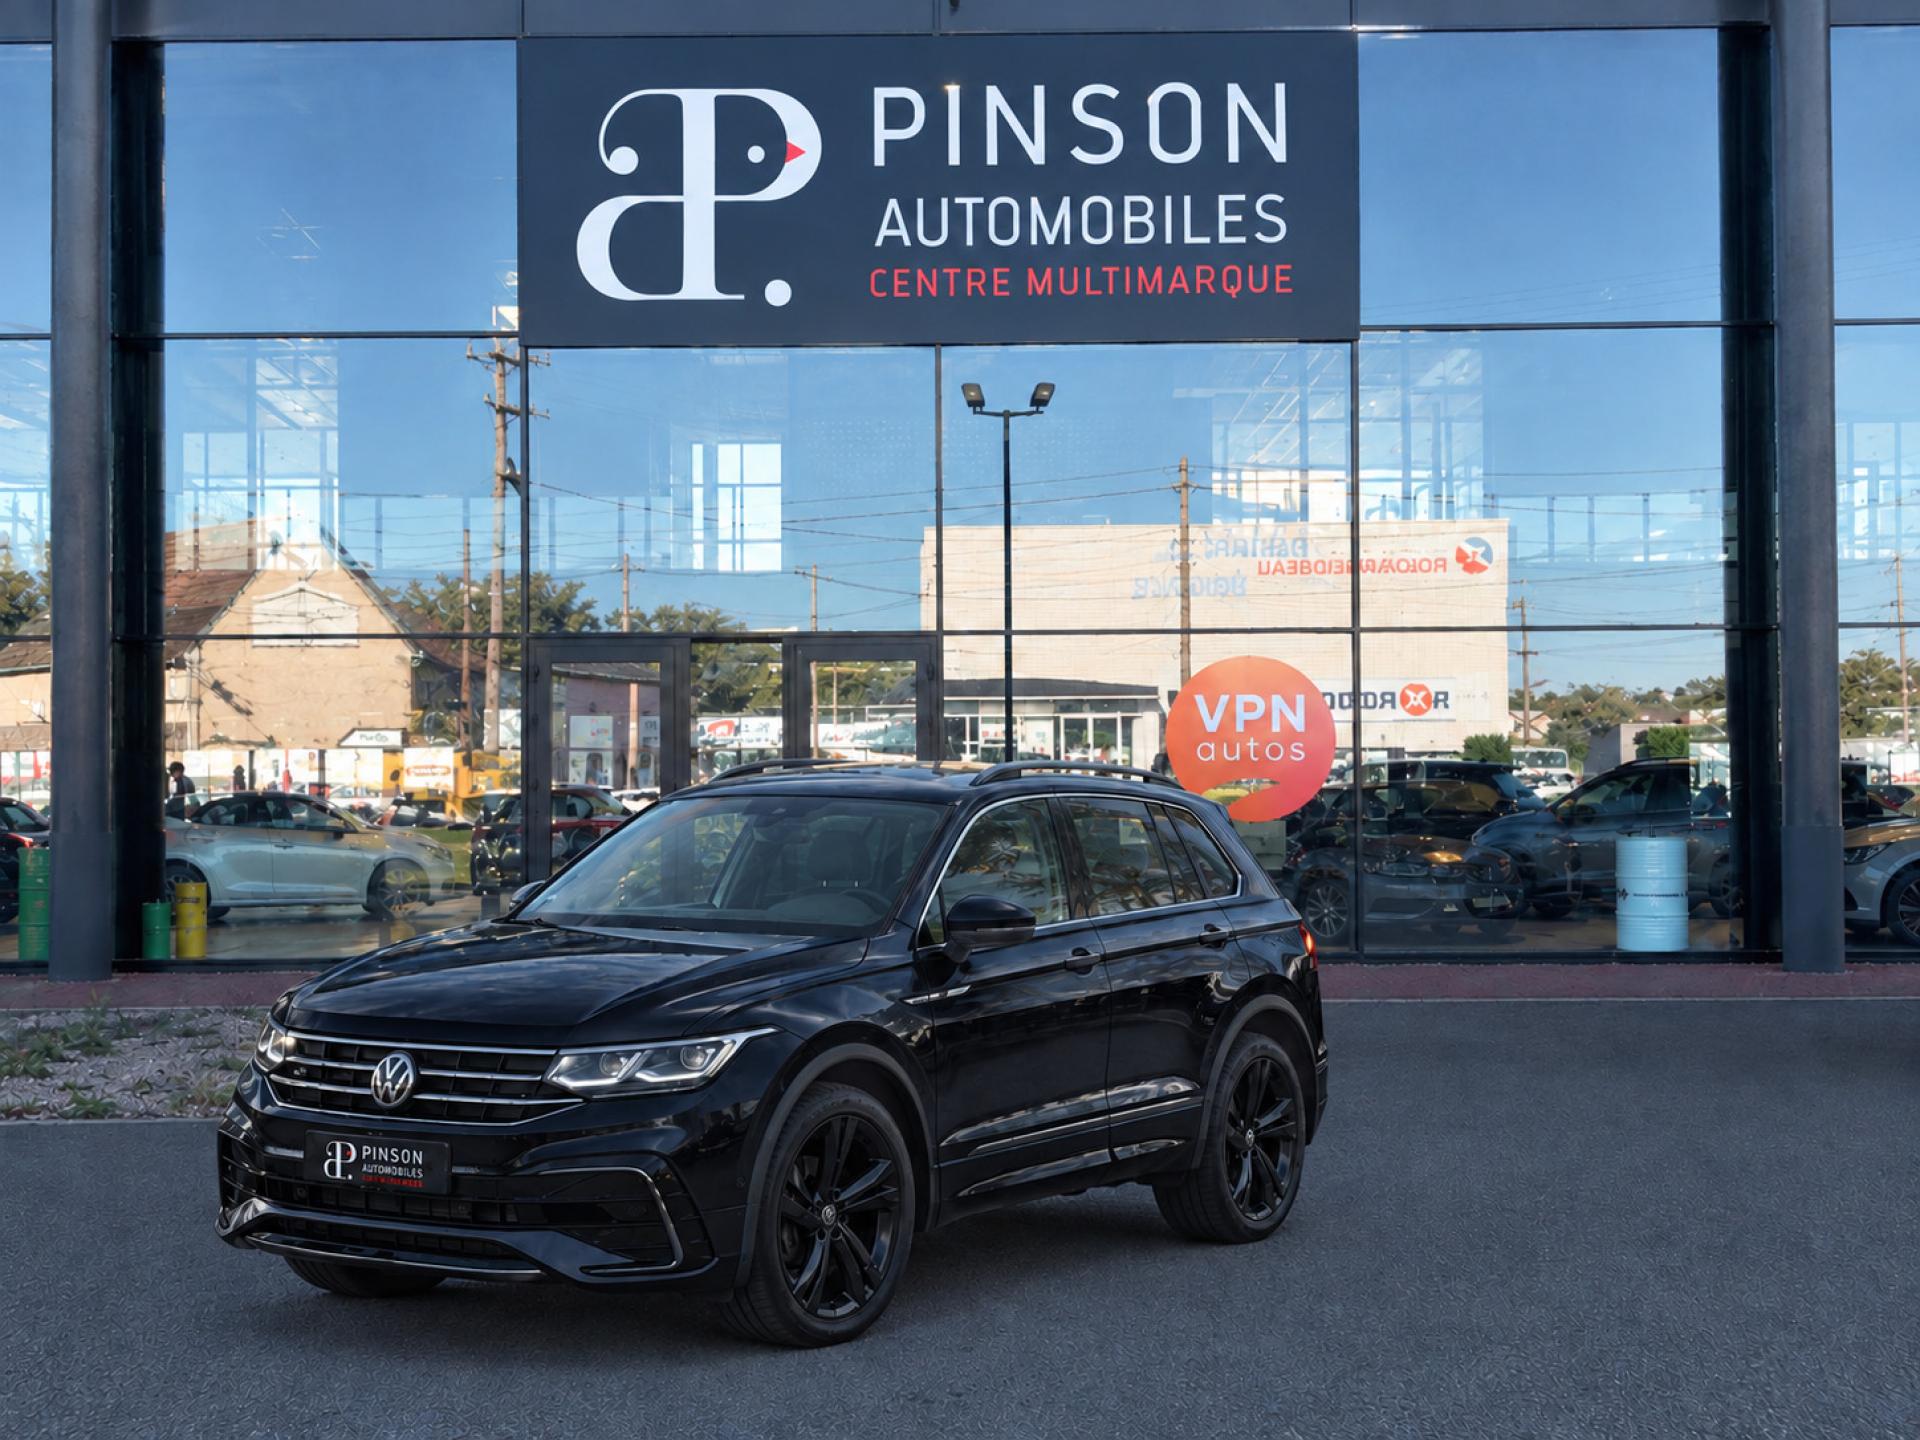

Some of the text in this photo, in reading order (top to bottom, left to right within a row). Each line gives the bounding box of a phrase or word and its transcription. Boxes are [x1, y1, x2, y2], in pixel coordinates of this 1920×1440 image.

[873, 82, 1288, 168] PINSON
[874, 193, 1288, 248] AUTOMOBILES
[870, 264, 1293, 299] CENTRE MULTIMARQUE
[1194, 694, 1306, 733] VPN
[1196, 737, 1306, 762] autos
[361, 1145, 424, 1166] PINSON
